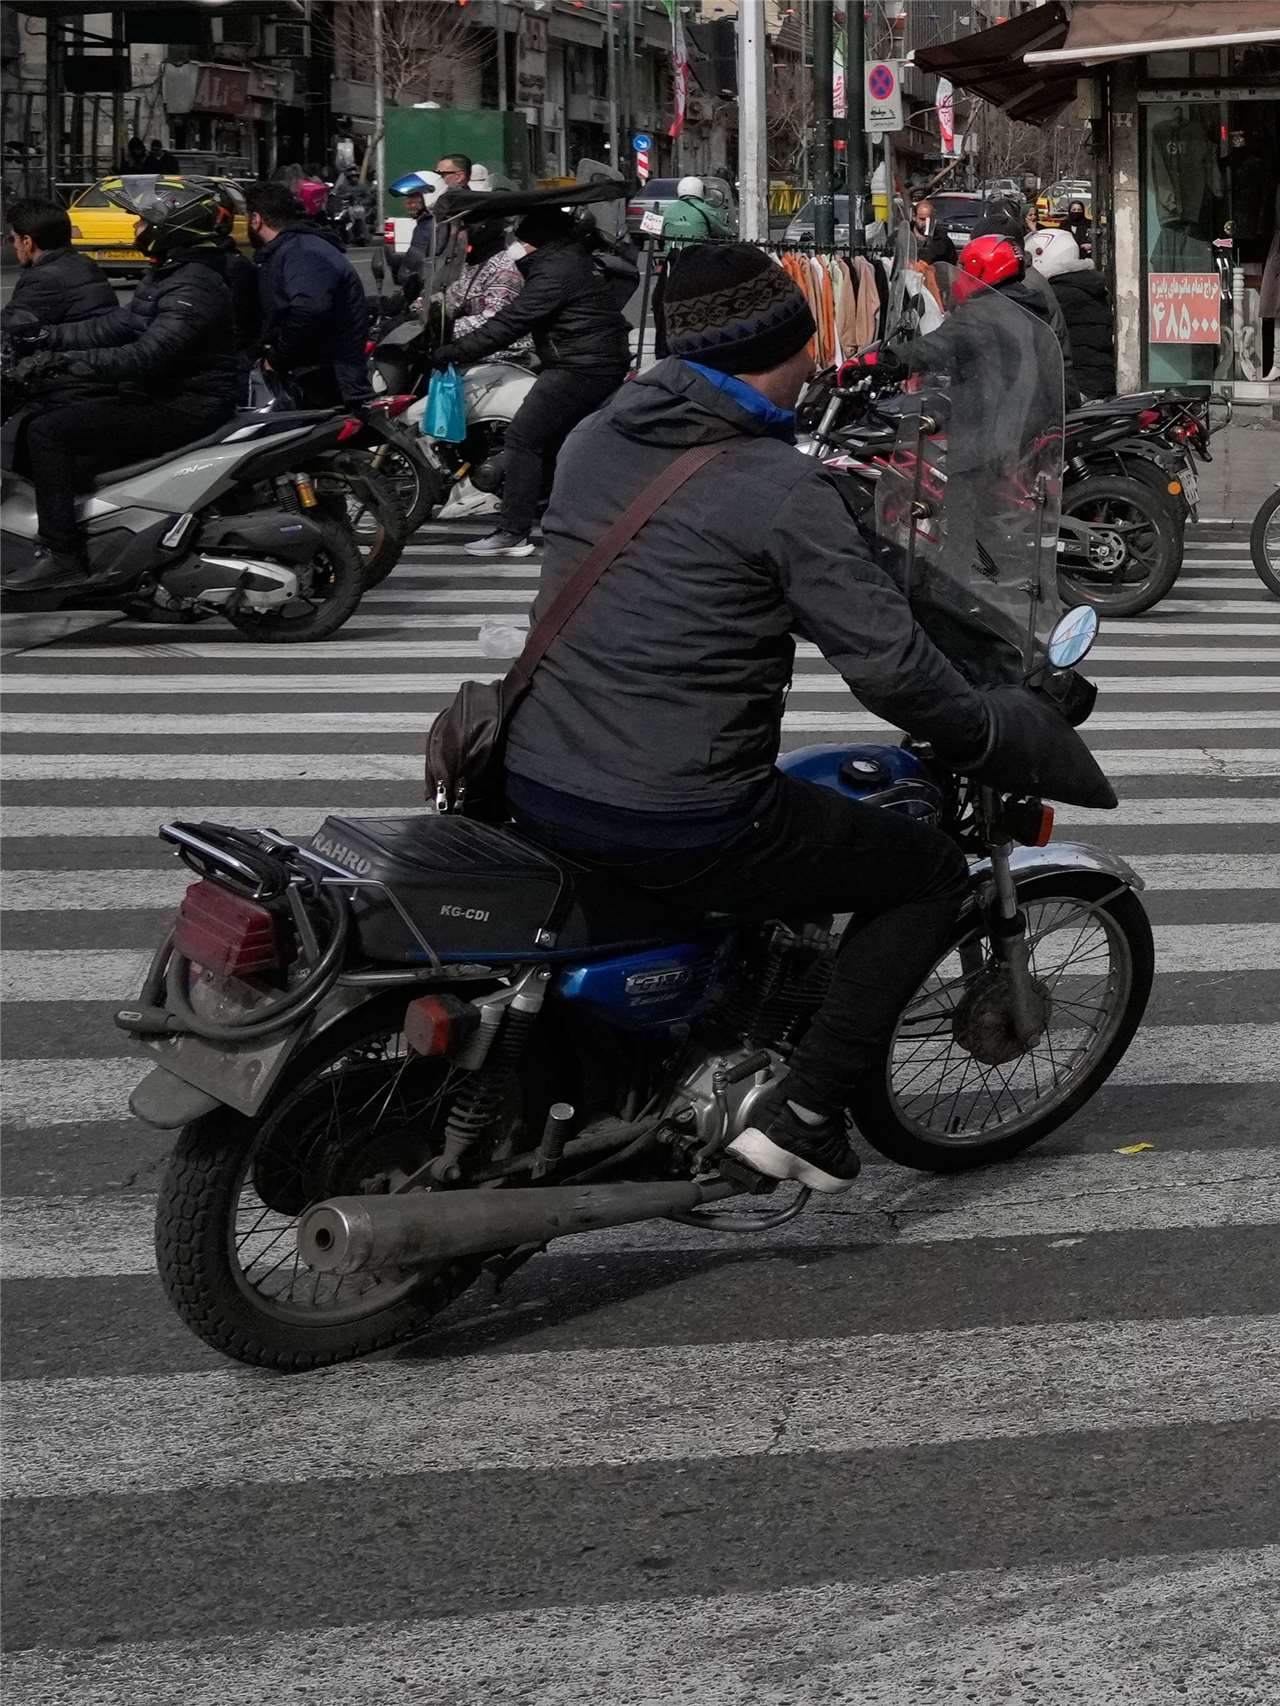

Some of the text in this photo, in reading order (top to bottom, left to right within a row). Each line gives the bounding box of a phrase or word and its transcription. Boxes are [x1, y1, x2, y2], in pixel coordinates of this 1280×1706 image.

[1152, 302, 1218, 340] ۴۸۵۰۰۰
[310, 831, 372, 876] RAHRO
[439, 904, 491, 923] KG-CDI
